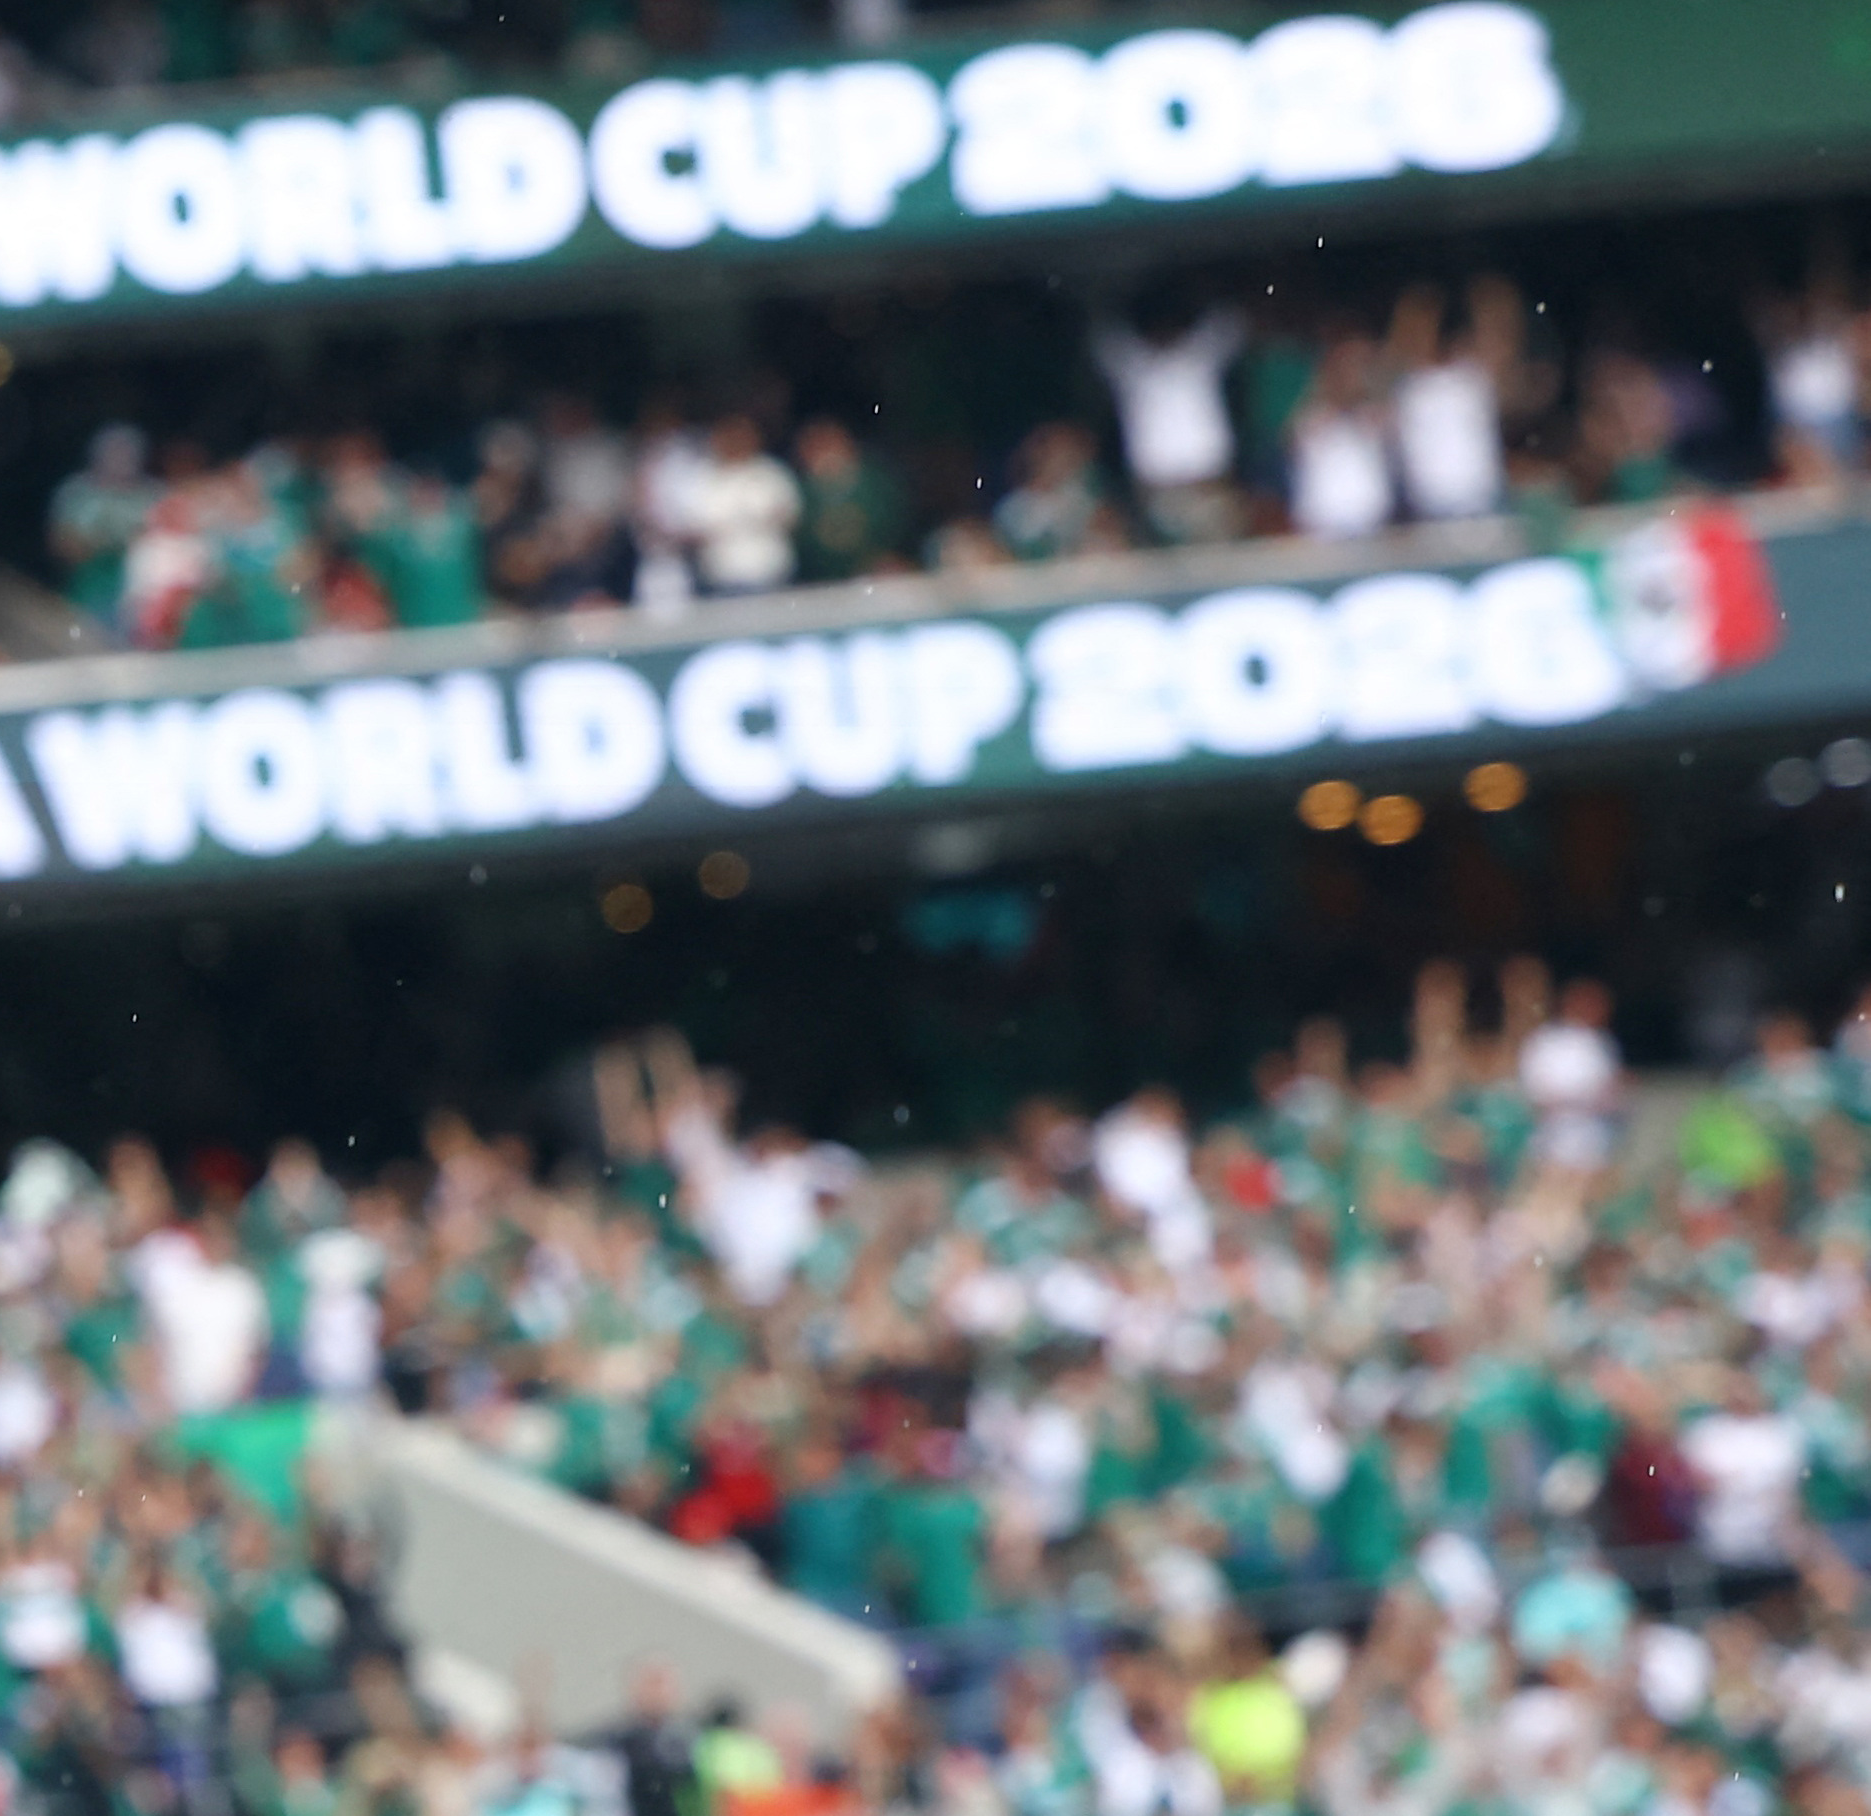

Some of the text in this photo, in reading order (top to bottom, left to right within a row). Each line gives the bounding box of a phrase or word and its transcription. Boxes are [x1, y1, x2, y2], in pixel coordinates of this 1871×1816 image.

[588, 60, 950, 251] CUP
[946, 1, 1564, 216] 2026
[27, 658, 662, 872] WORLD
[667, 618, 1023, 807] CUP
[1025, 556, 1626, 772] 2026
